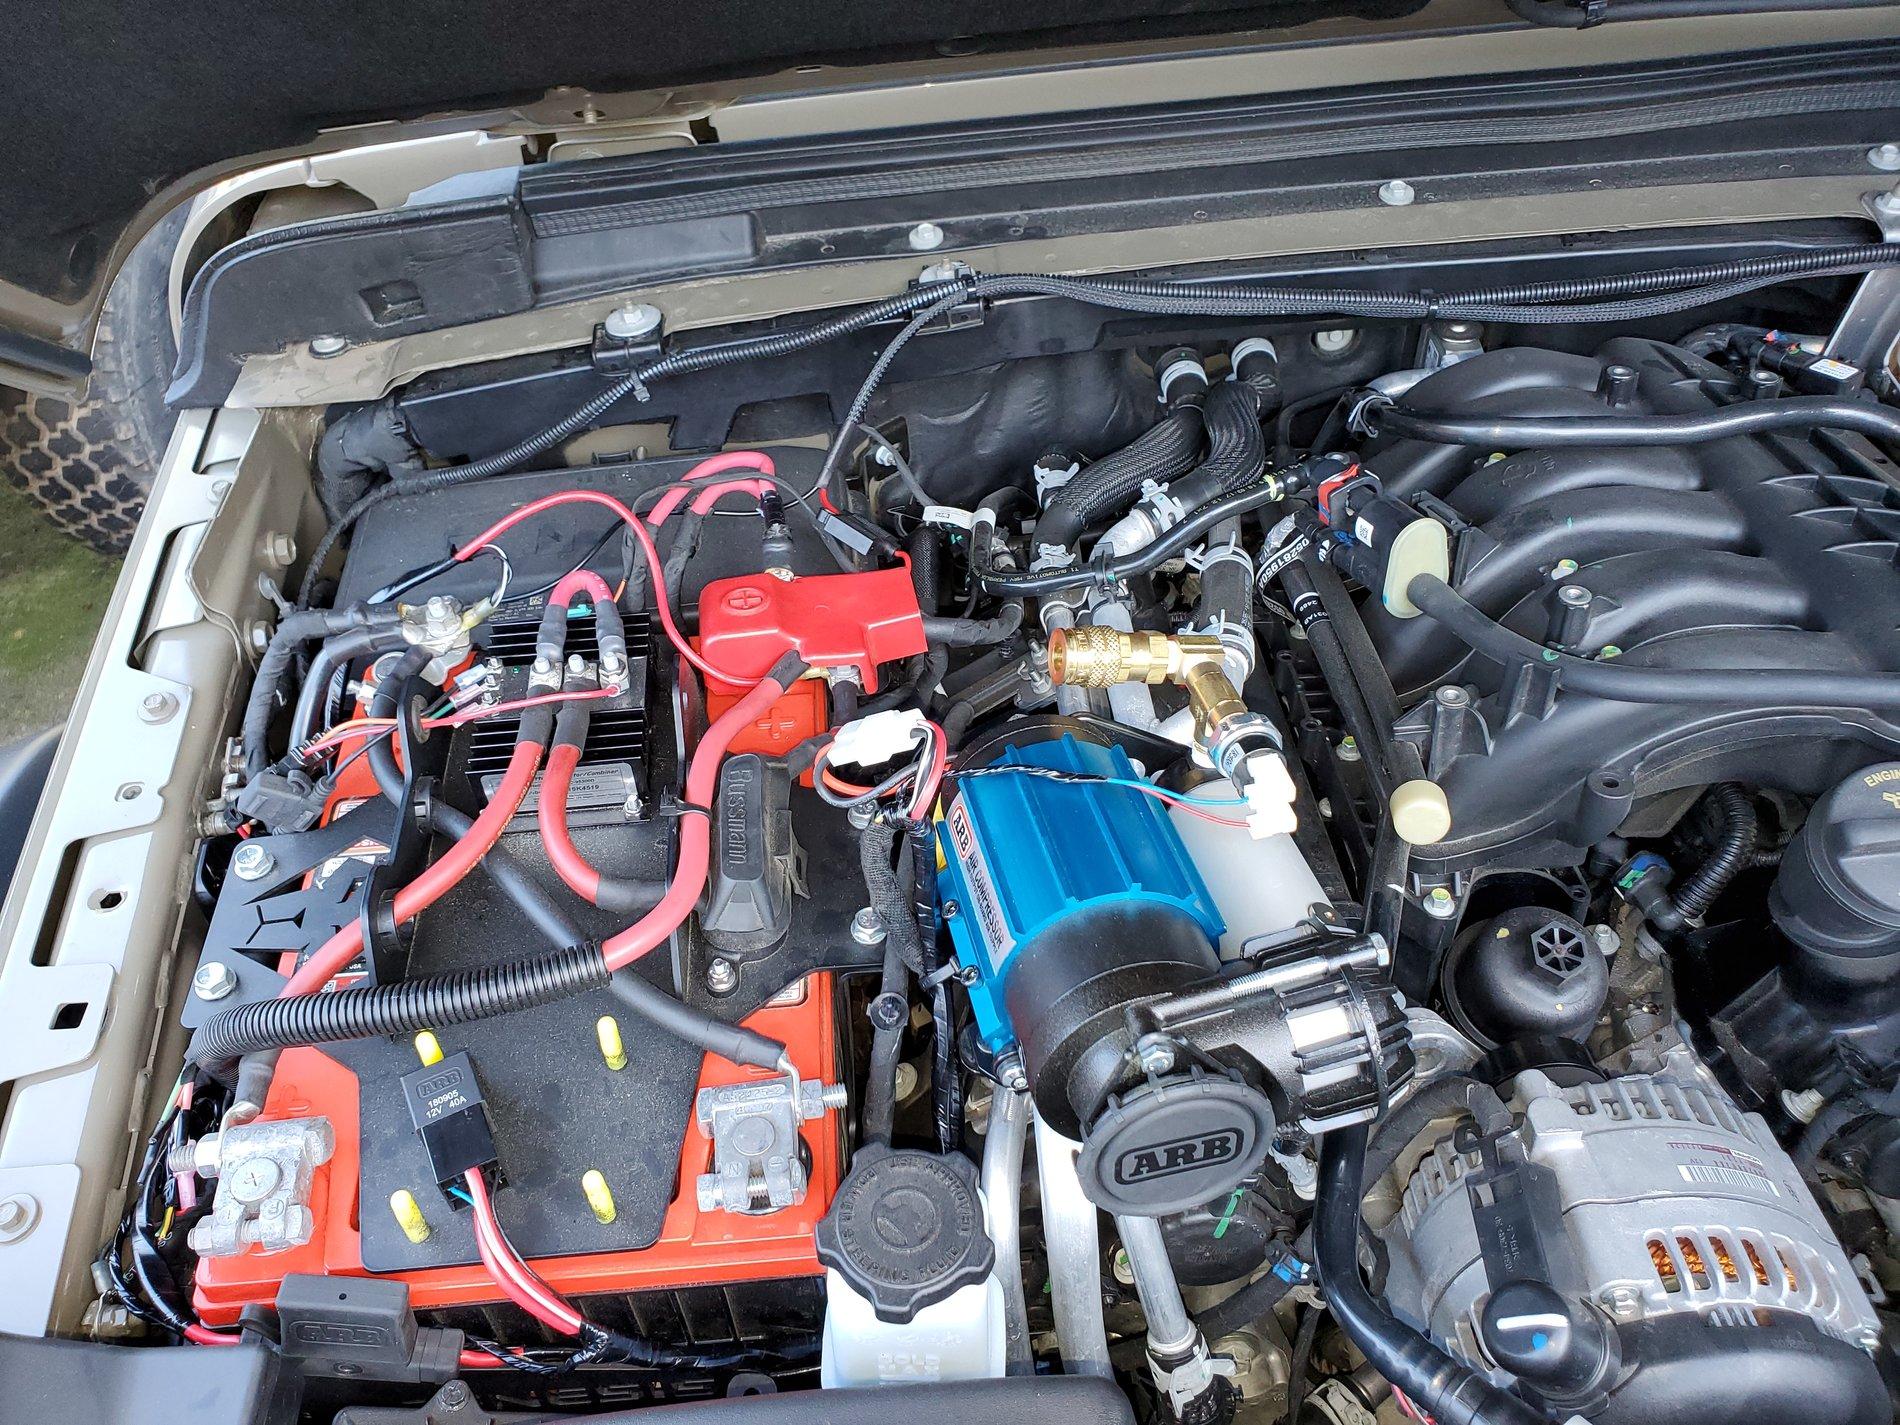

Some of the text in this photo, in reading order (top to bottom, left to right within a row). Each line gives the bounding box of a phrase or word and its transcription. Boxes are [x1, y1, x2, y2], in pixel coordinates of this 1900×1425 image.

[953, 812, 1005, 951] ARB AIR COMPRESSOR
[425, 1095, 467, 1119] 12V 40A
[427, 1089, 459, 1109] 180905
[1129, 1135, 1232, 1178] ARB
